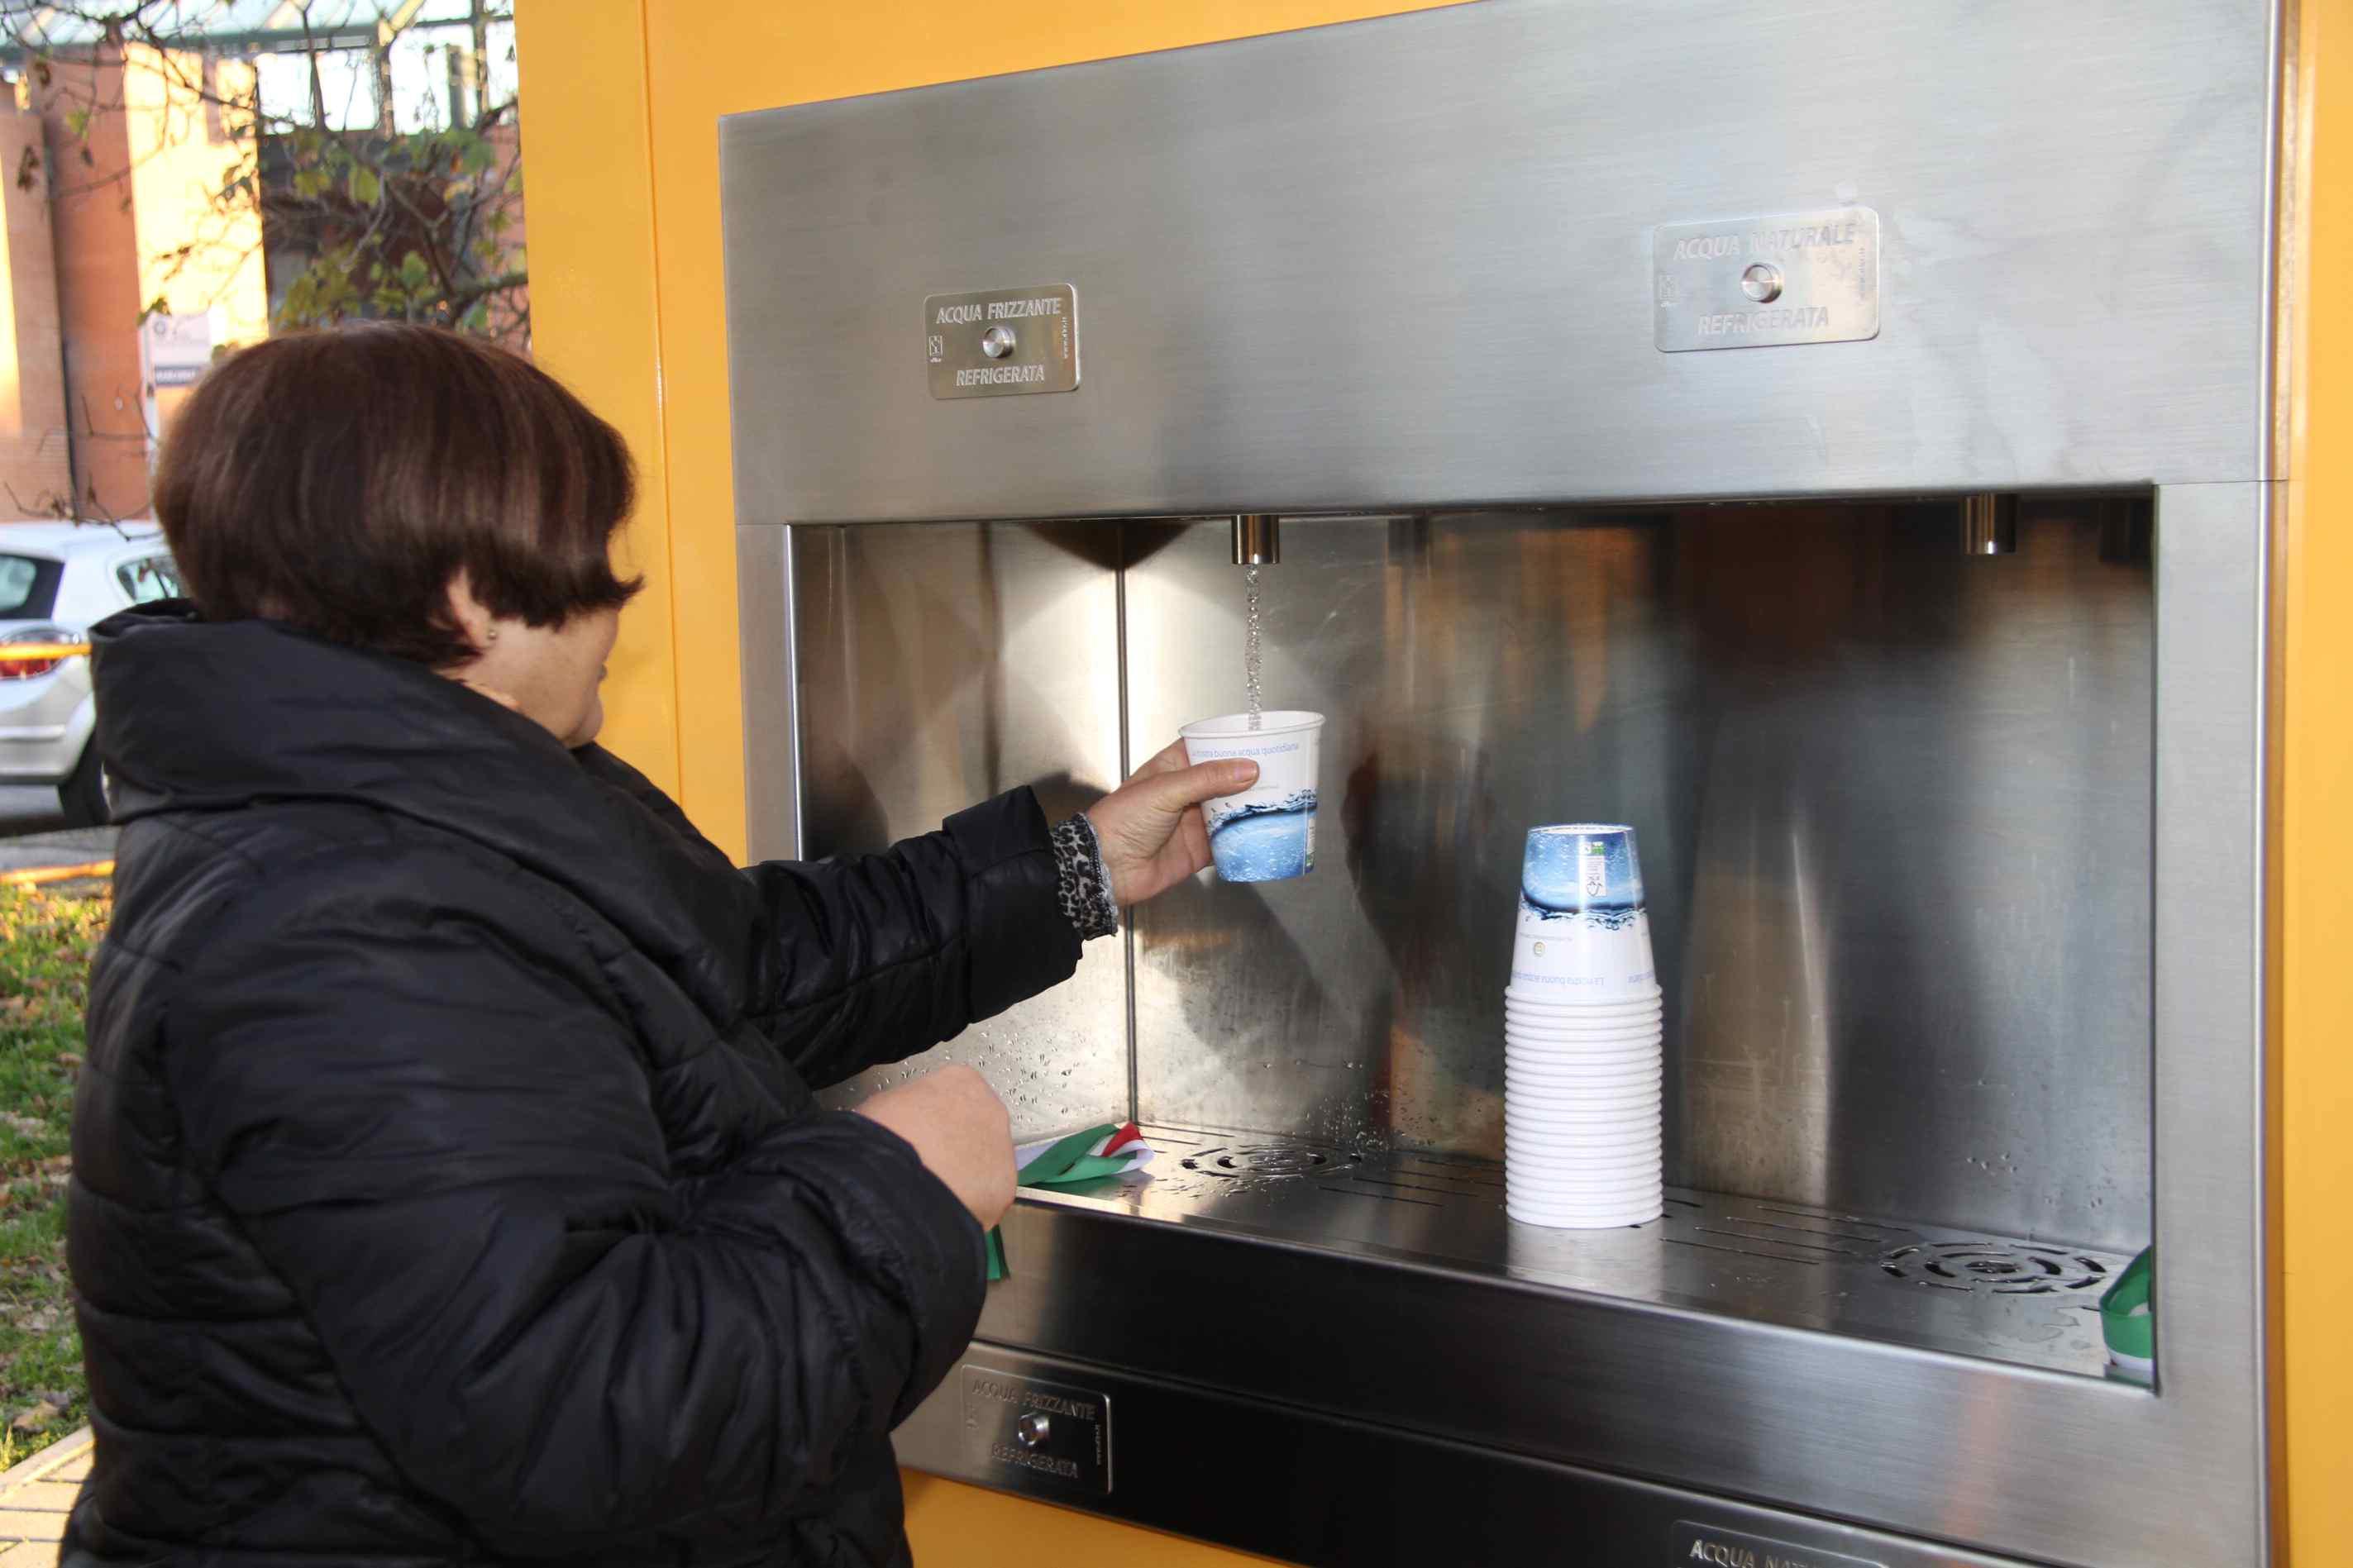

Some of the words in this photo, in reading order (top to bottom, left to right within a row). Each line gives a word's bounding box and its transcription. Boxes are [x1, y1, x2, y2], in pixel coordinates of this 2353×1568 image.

[1673, 234, 1740, 260] ACQUA
[1752, 223, 1855, 250] NATURALE
[936, 304, 982, 325] ACQUA
[988, 298, 1062, 320] FRIZZANTE
[1697, 307, 1829, 336] REFRIGERATA
[957, 365, 1045, 386] REFRIGERATA
[972, 1379, 1019, 1404] ACQUA
[1024, 1391, 1096, 1421] FRIZZANTE
[992, 1442, 1078, 1478] REFRIGERATA
[1689, 1539, 1755, 1568] ACQUA
